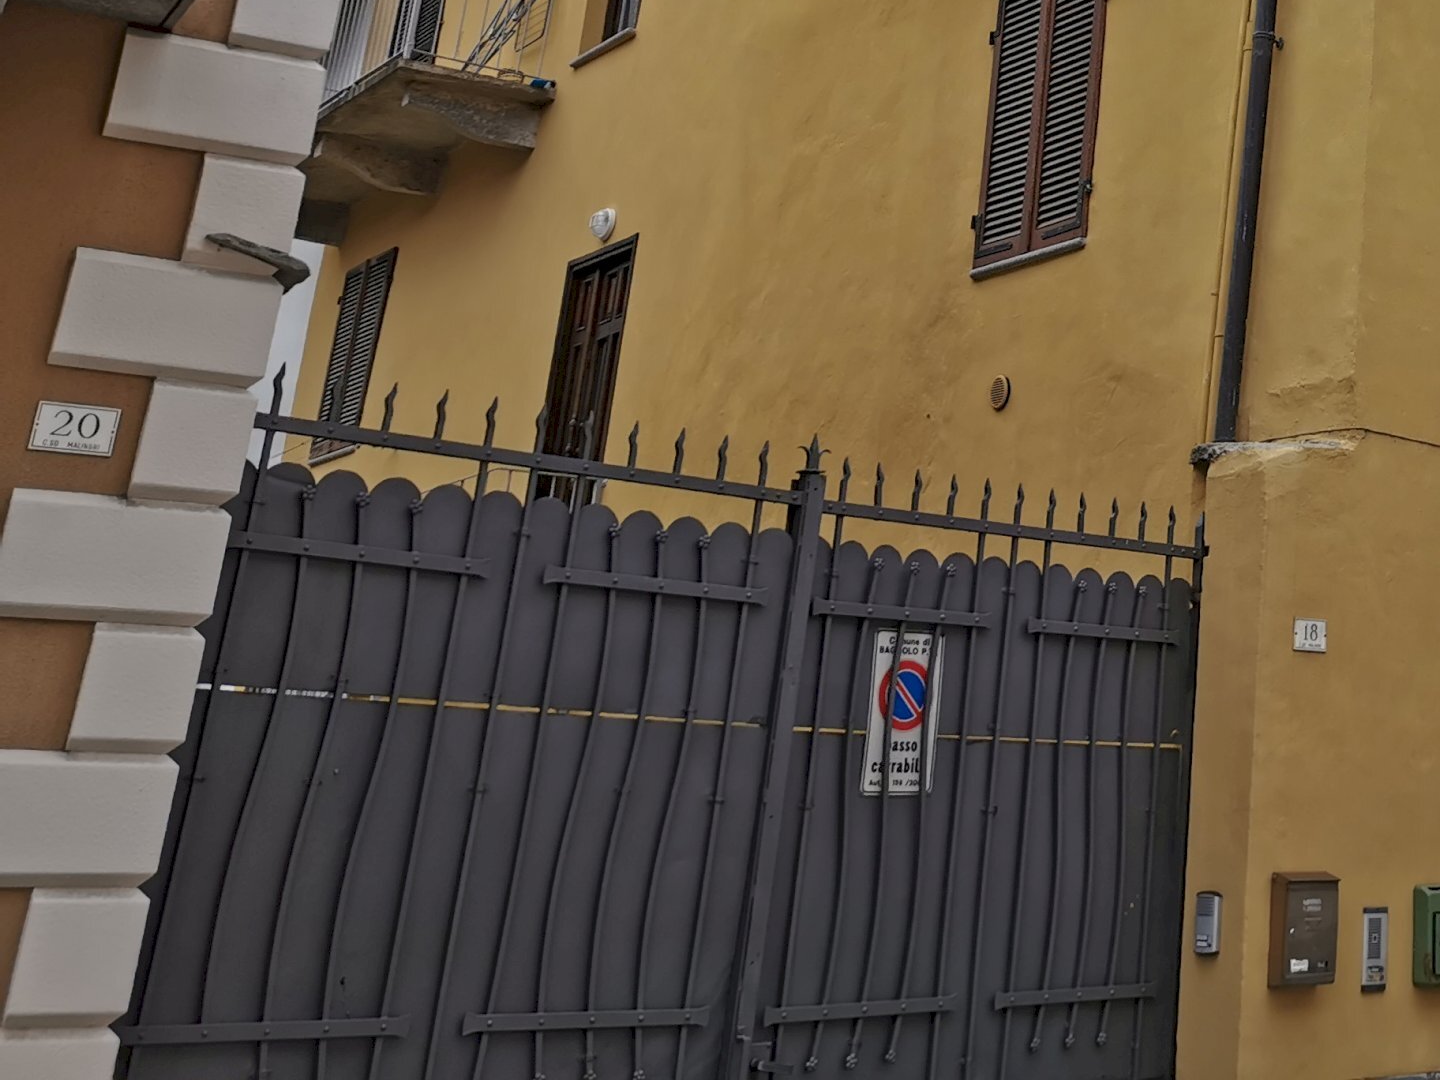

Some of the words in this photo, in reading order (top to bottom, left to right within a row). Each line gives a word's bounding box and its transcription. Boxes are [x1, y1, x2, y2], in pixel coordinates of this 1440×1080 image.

[49, 410, 100, 439] 20
[1303, 623, 1318, 641] 18
[891, 741, 918, 752] asso
